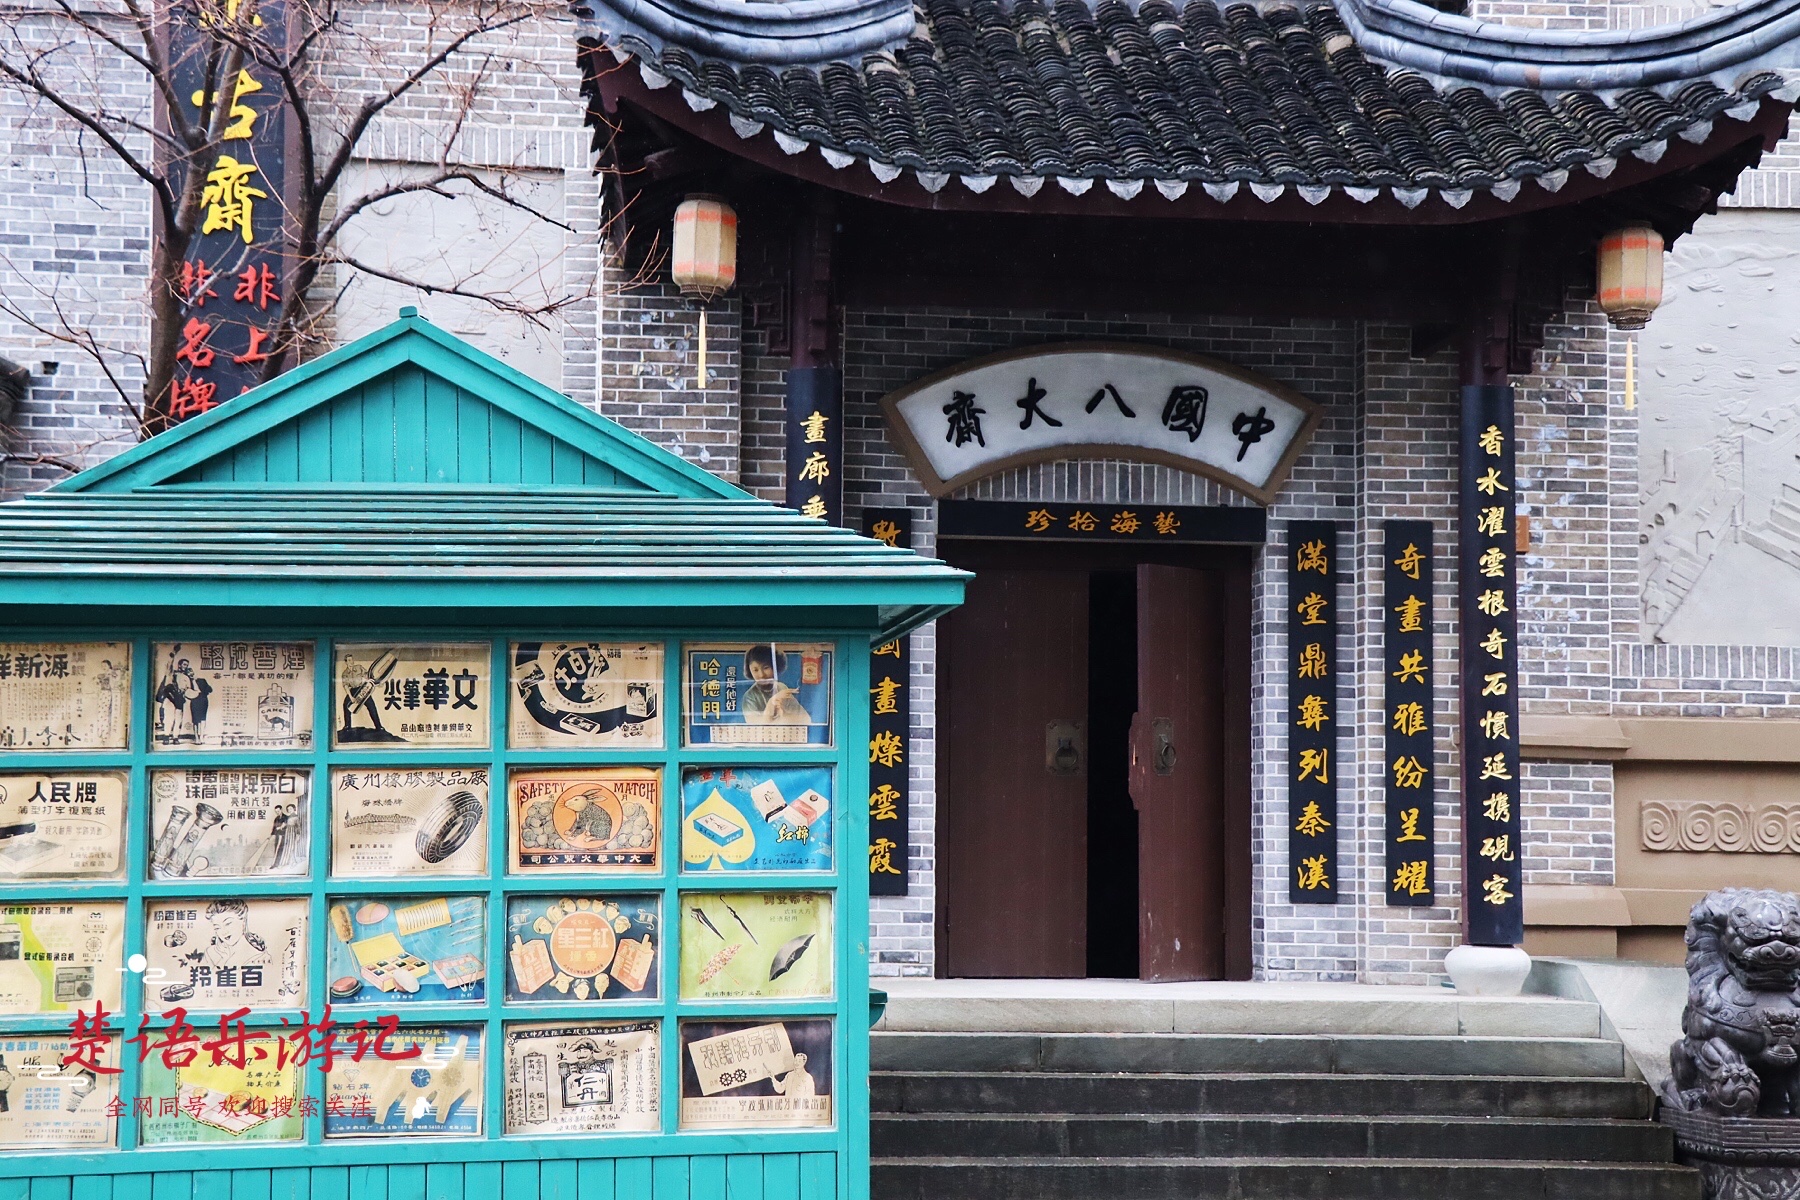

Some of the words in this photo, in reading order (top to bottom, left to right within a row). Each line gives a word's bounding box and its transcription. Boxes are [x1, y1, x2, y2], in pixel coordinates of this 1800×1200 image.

[233, 262, 281, 395] 非上
[1024, 508, 1181, 535] 藝海拾珍
[699, 658, 721, 720] 哈德門
[28, 781, 97, 804] 人民牌
[338, 770, 488, 791] 廣州橡膠製品廠
[519, 782, 566, 808] SAFETY
[614, 782, 656, 805] MATCH
[189, 965, 264, 987] 百雀羚
[574, 1075, 598, 1100] 仁丹
